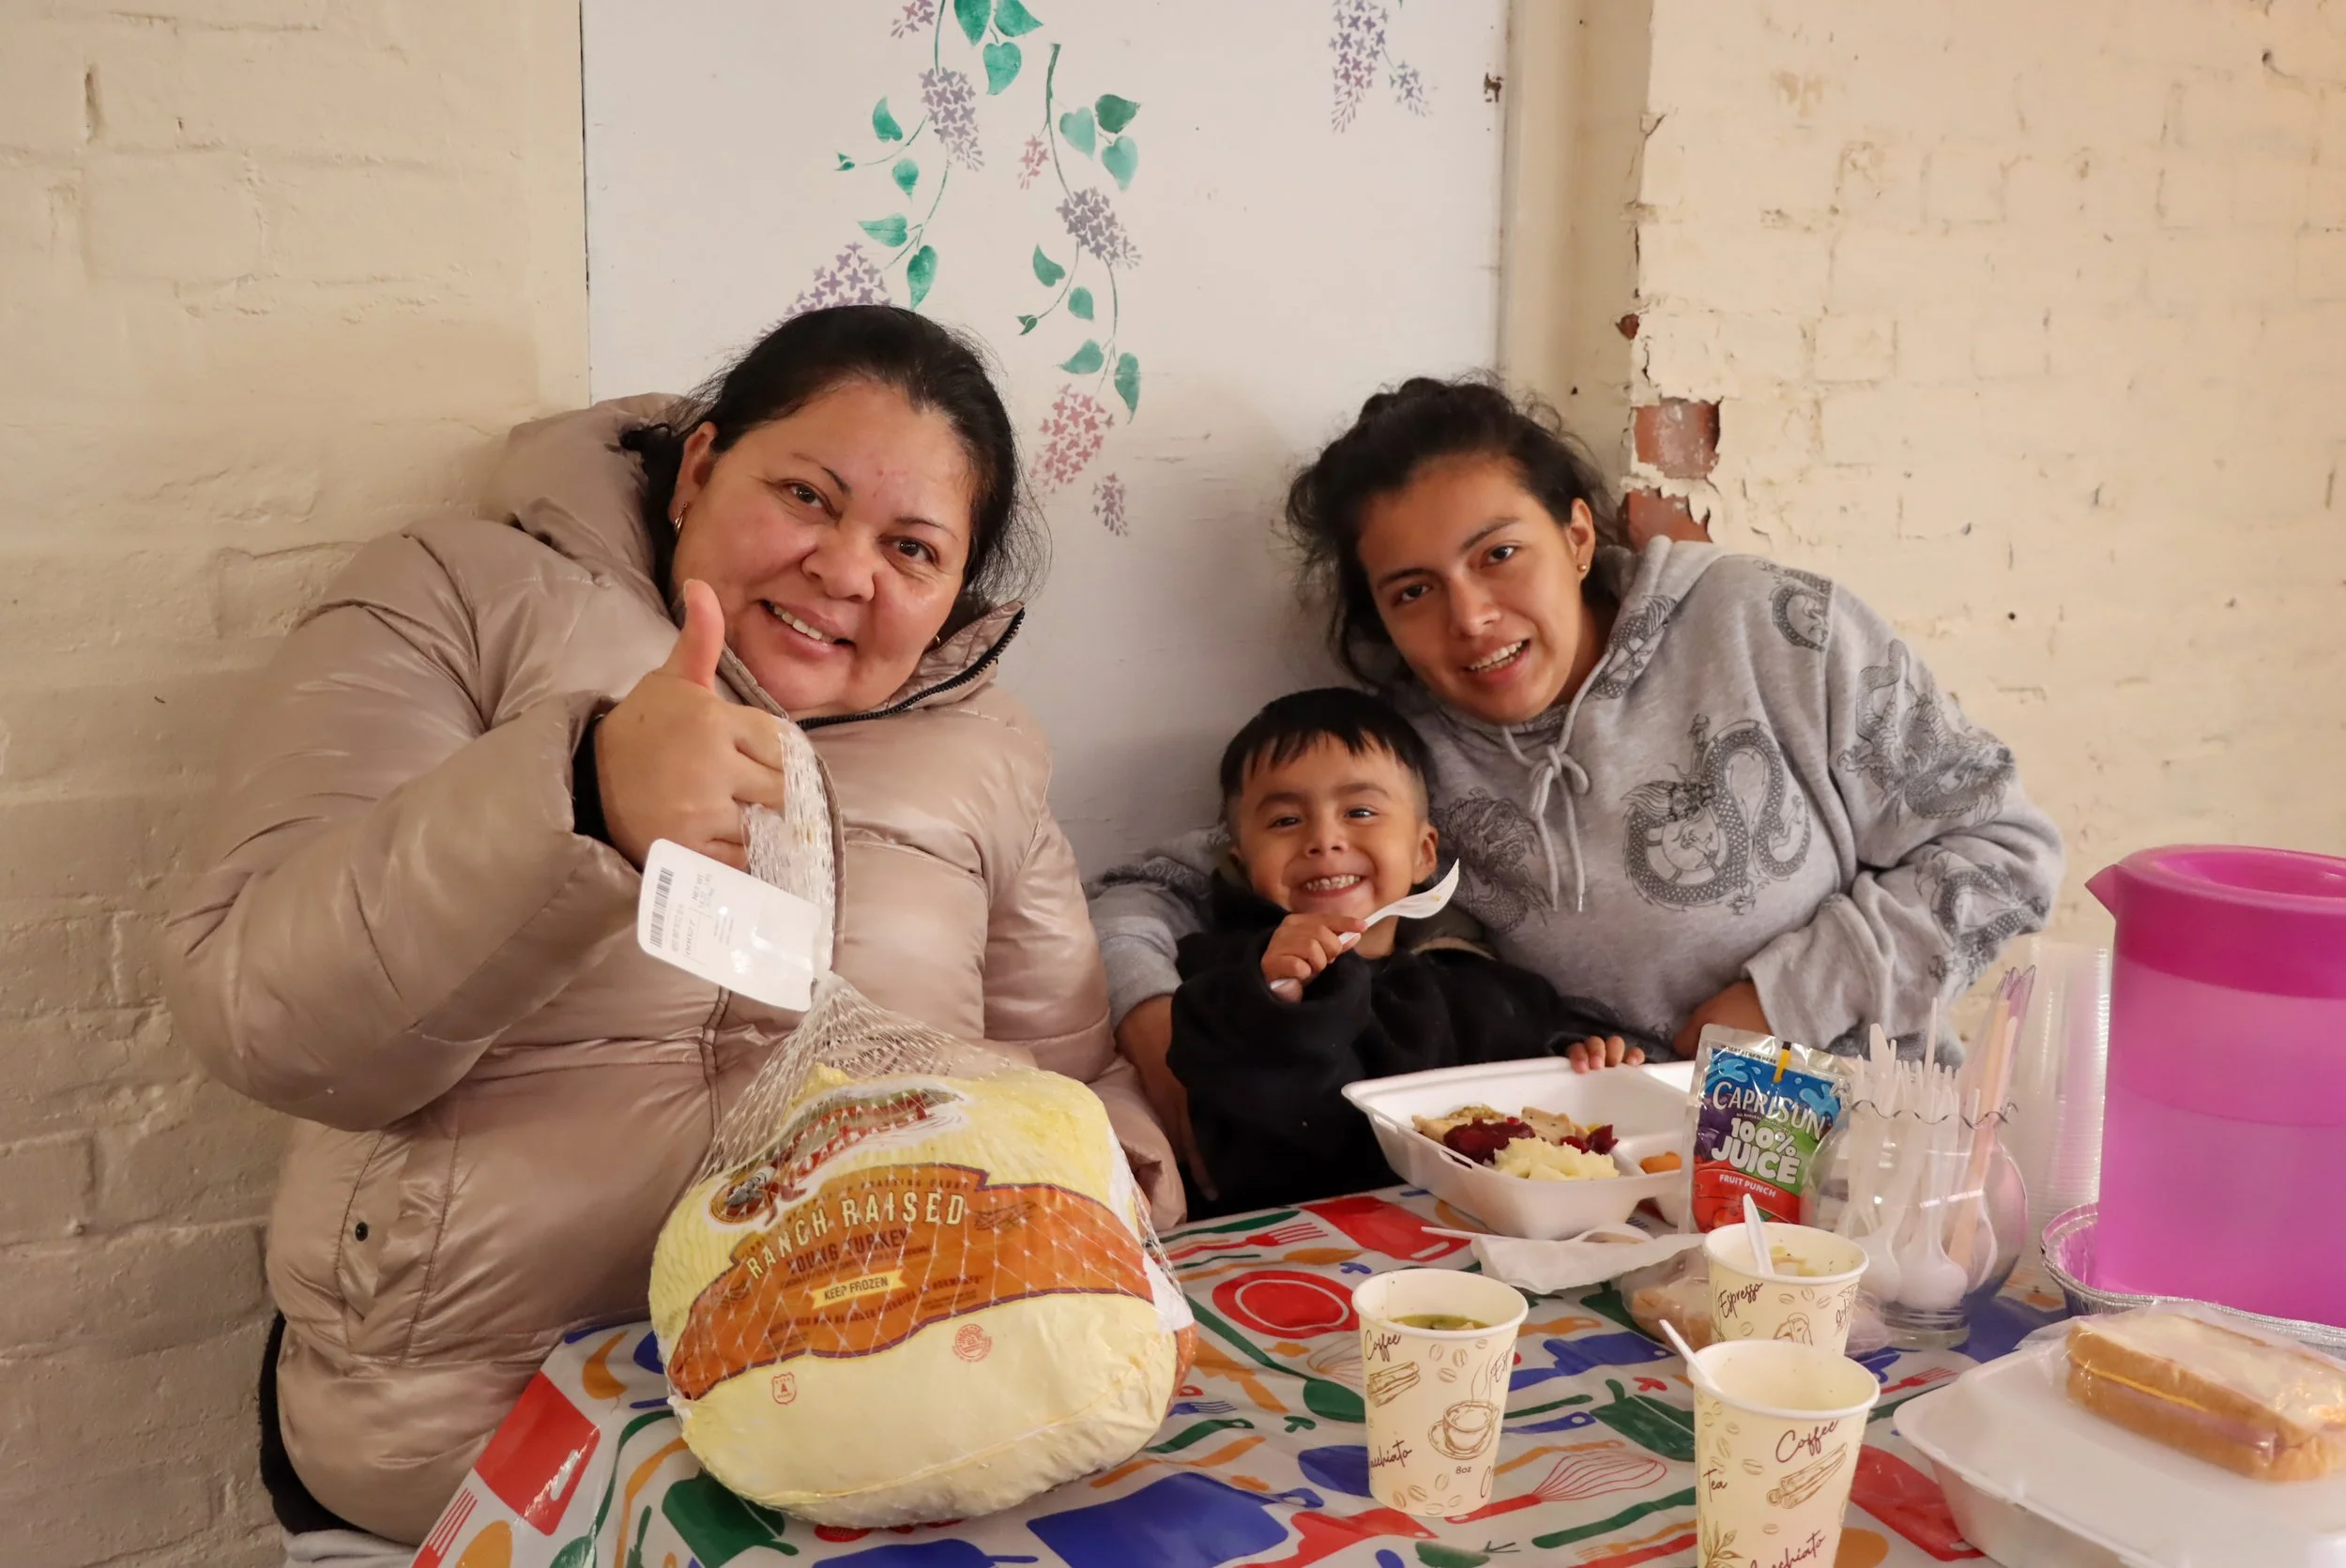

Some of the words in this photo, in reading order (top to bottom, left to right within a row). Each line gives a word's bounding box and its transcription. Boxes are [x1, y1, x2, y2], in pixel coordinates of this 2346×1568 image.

[1730, 1117, 1797, 1157] 100%
[1711, 1135, 1801, 1184] JUICE
[1719, 1174, 1744, 1188] FRUIT
[1744, 1180, 1776, 1198] PUNCH
[746, 1208, 828, 1279] RANCH
[841, 1191, 964, 1227] RAISED
[846, 1228, 907, 1256] TURKEY
[824, 1286, 846, 1301] KEEP
[849, 1276, 888, 1293] FROZEN
[1718, 1283, 1763, 1318] Espresso
[1364, 1329, 1401, 1362] Coffee
[1775, 1419, 1839, 1463] Coffee
[1455, 1466, 1471, 1474] 8oz
[1703, 1468, 1728, 1502] Tea
